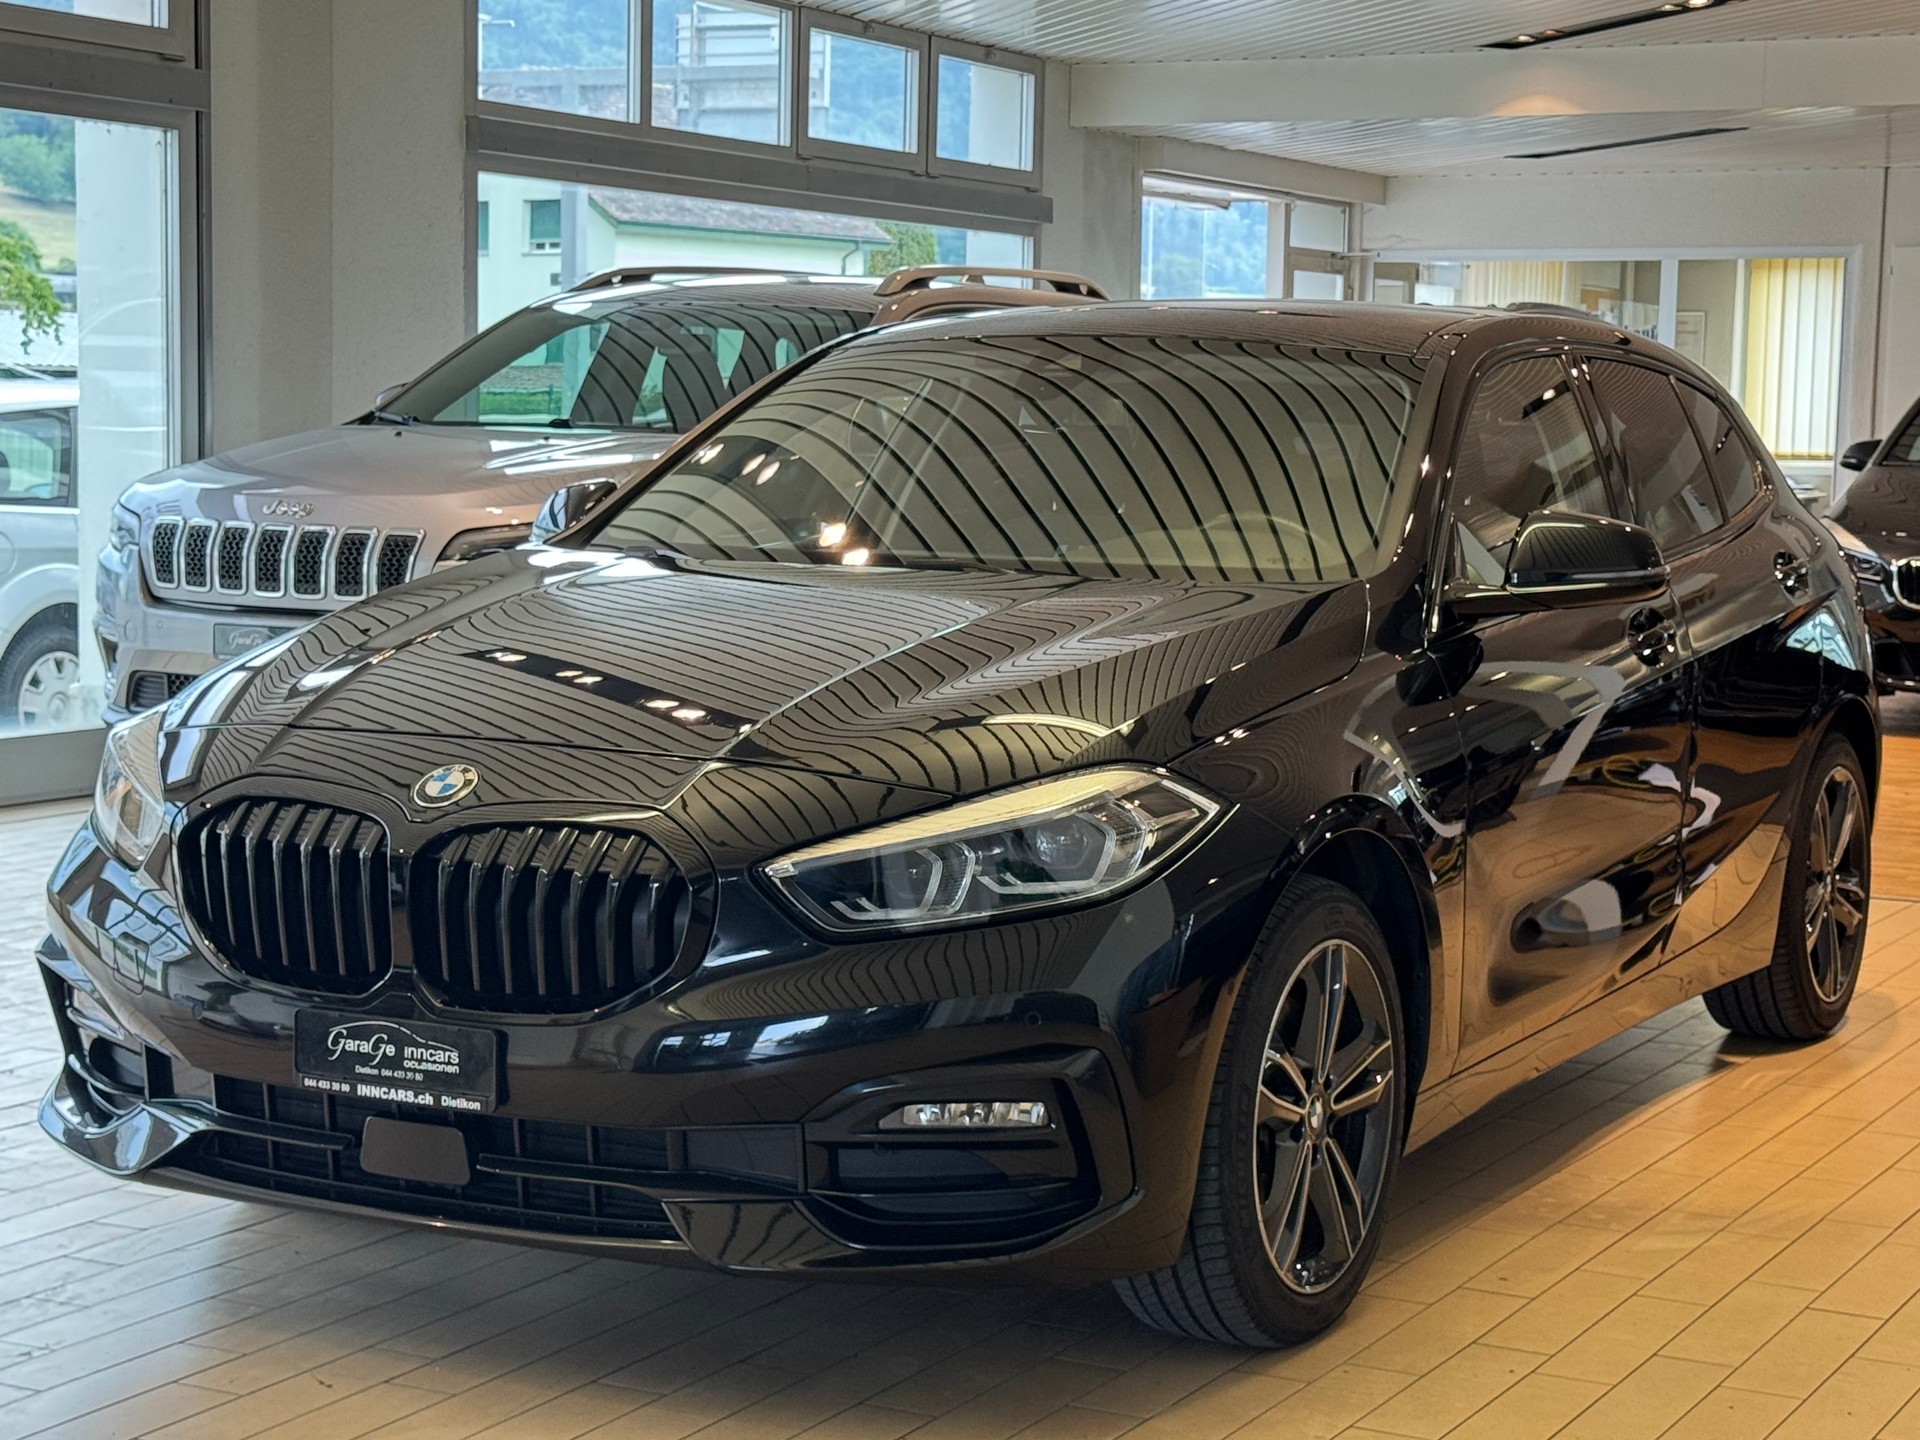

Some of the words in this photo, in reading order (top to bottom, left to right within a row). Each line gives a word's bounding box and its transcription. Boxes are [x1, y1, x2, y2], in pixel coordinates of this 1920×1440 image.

[263, 499, 314, 519] Jeep
[327, 1028, 396, 1066] GaraGe
[404, 1046, 460, 1064] inncars
[357, 1083, 434, 1106] INNCARS.ch
[441, 1095, 481, 1111] Dietikon
